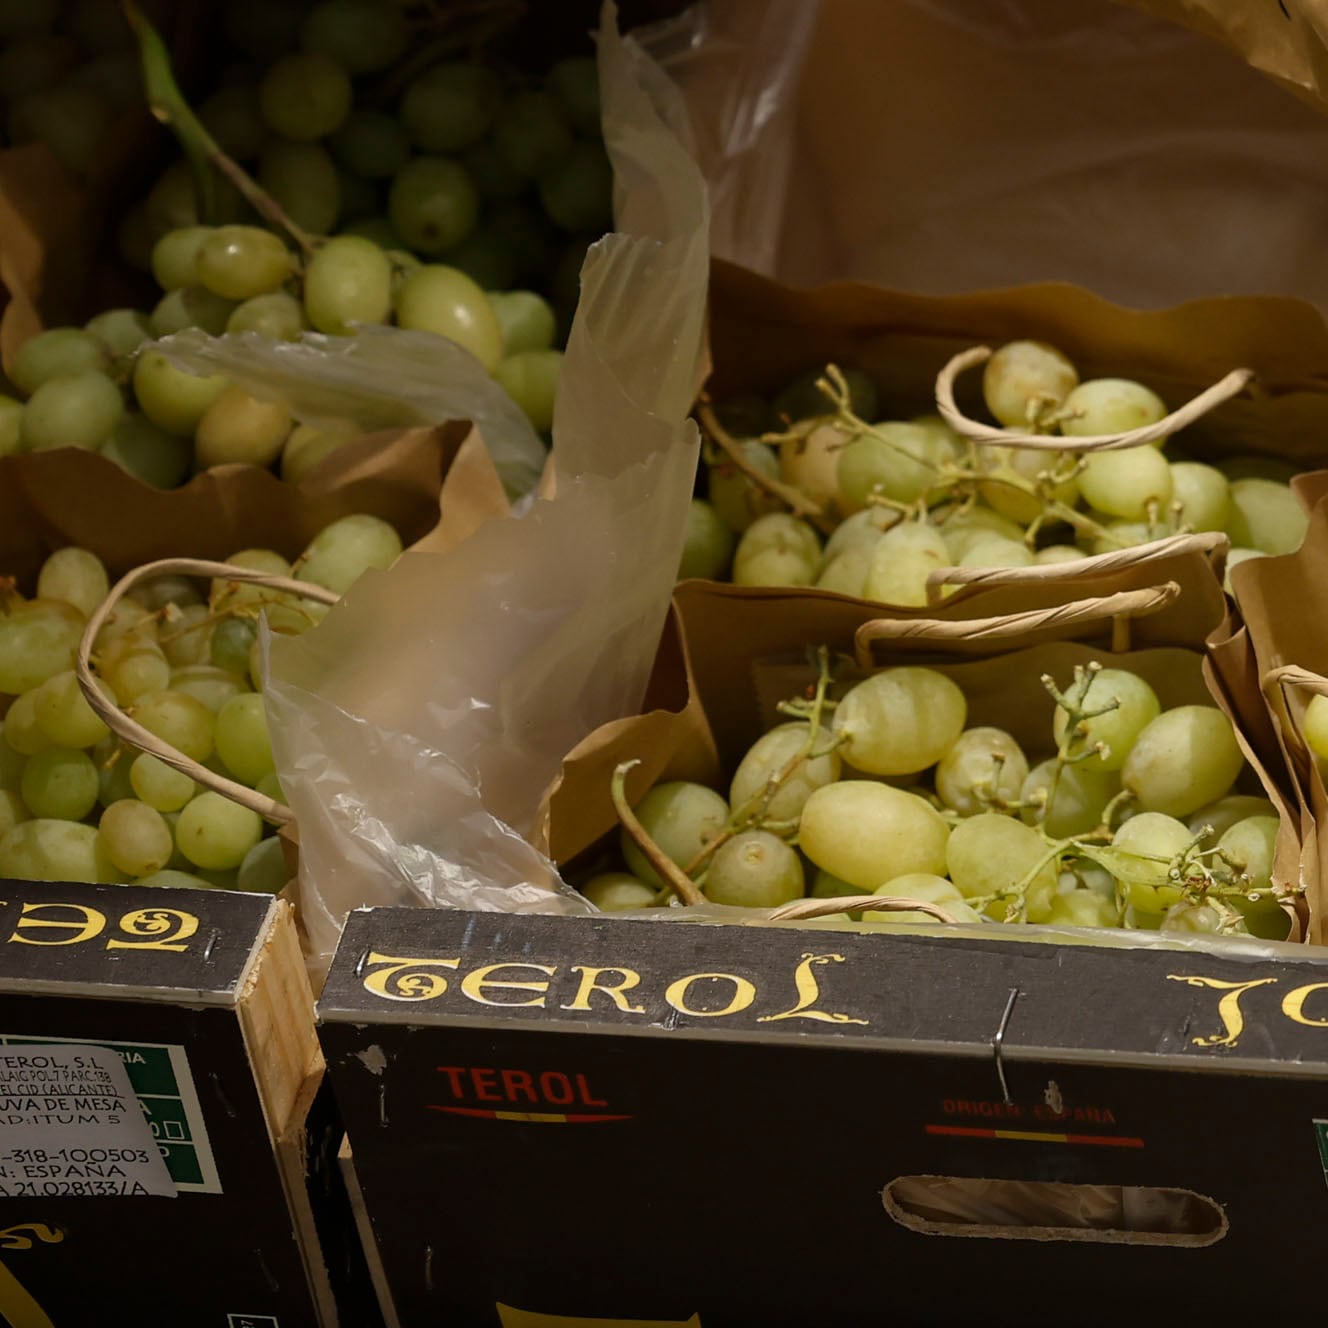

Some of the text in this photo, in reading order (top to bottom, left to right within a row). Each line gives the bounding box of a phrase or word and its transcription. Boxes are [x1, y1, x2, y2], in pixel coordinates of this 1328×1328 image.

[361, 950, 870, 1026] TEROL
[436, 1065, 609, 1108] TEROL
[44, 1098, 70, 1112] DE
[74, 1098, 127, 1113] MESA
[23, 1160, 127, 1179] ESPAÑA
